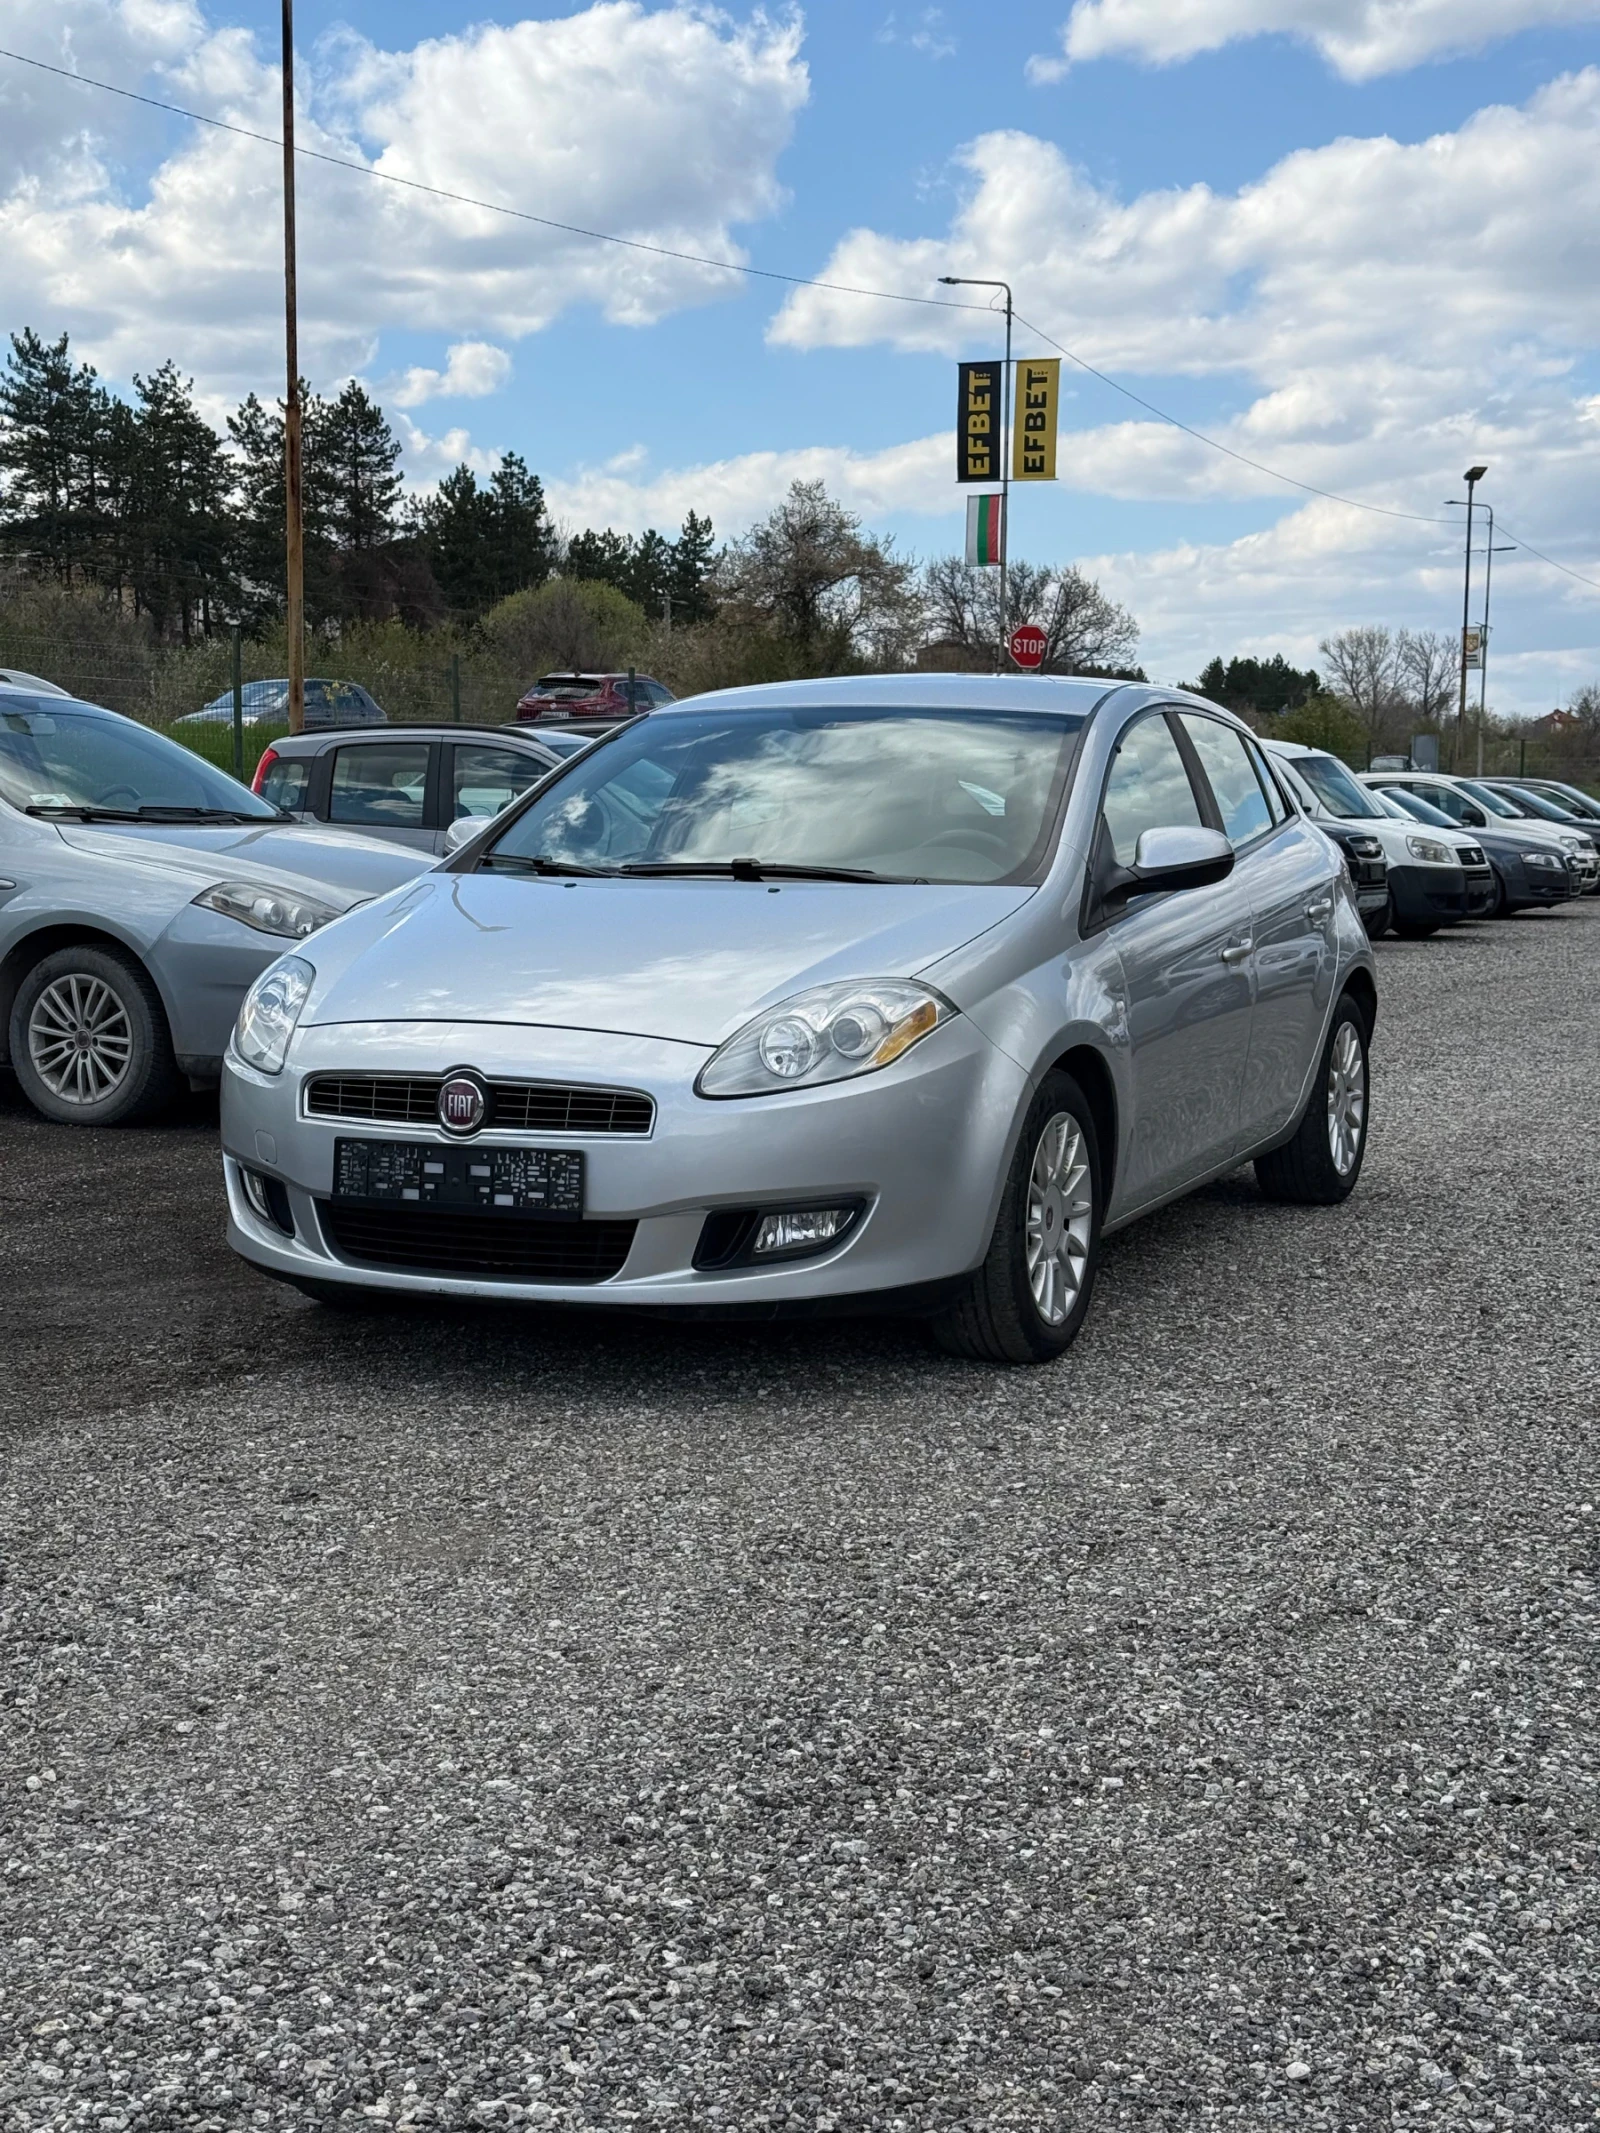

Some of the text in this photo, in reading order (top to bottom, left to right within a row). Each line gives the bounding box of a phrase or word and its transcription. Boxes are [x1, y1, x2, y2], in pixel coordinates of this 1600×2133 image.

[968, 370, 990, 475] EFBET
[1024, 368, 1048, 472] EFBET
[1013, 638, 1045, 655] STOP
[448, 1094, 474, 1117] FIAT
